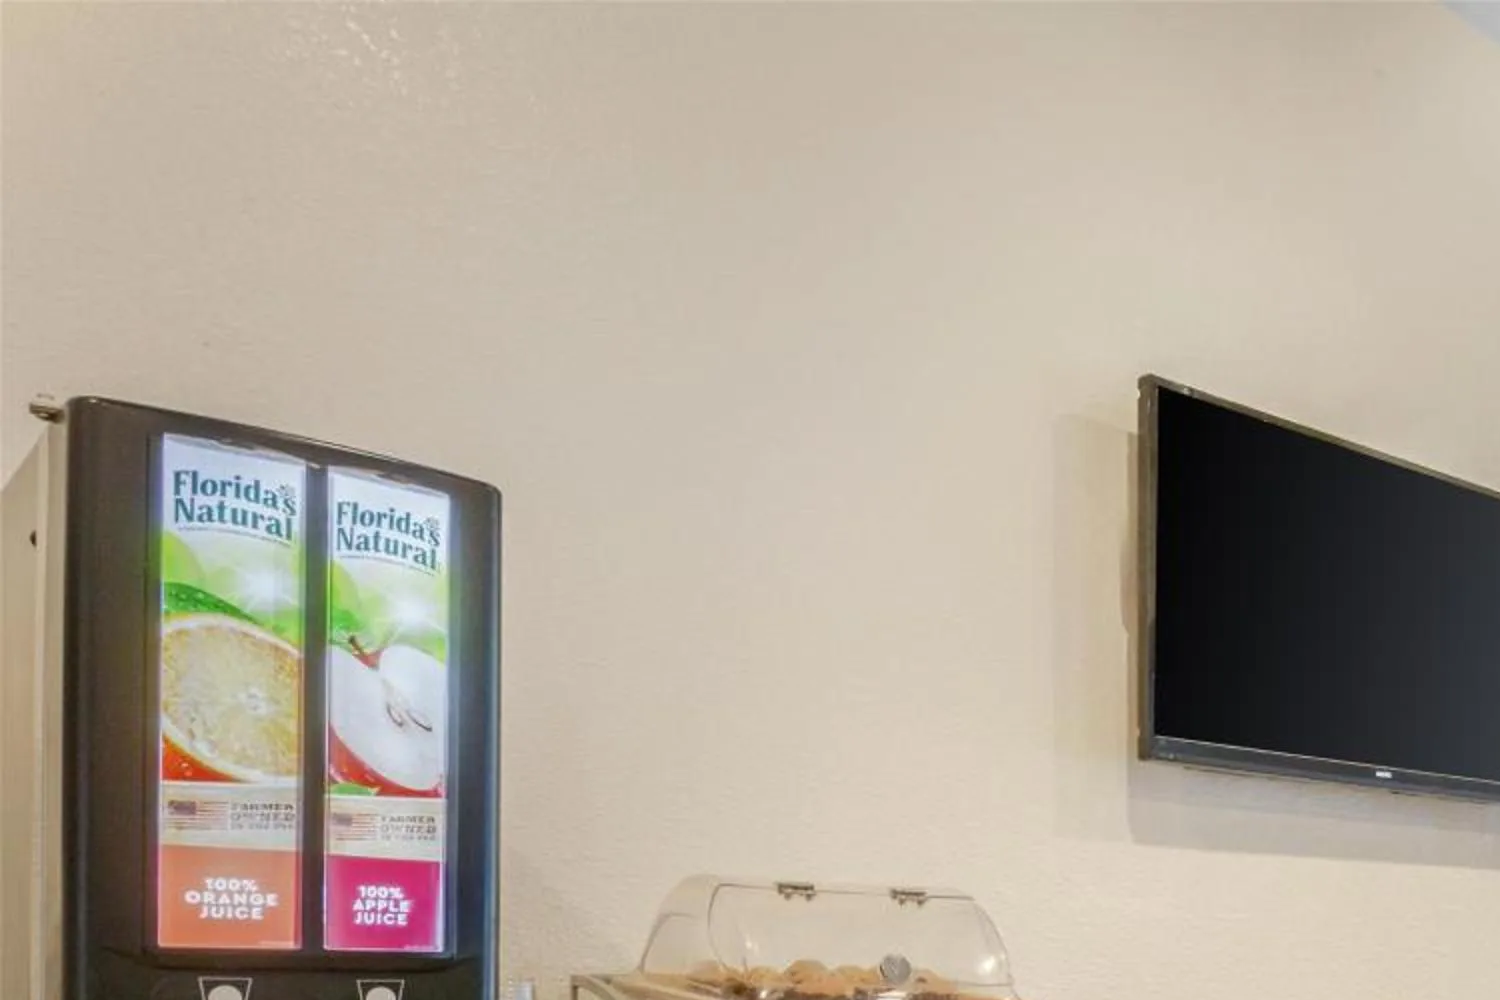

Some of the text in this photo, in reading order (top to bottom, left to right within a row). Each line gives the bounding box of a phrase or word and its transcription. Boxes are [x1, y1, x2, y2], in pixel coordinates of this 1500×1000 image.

[174, 497, 293, 541] Natural
[336, 527, 437, 570] Natural
[205, 877, 258, 892] 100%
[358, 885, 404, 899] 100%
[184, 891, 279, 907] ORANGE
[353, 899, 411, 913] APPLE
[199, 904, 264, 921] JUICE
[354, 912, 408, 926] JUICE
